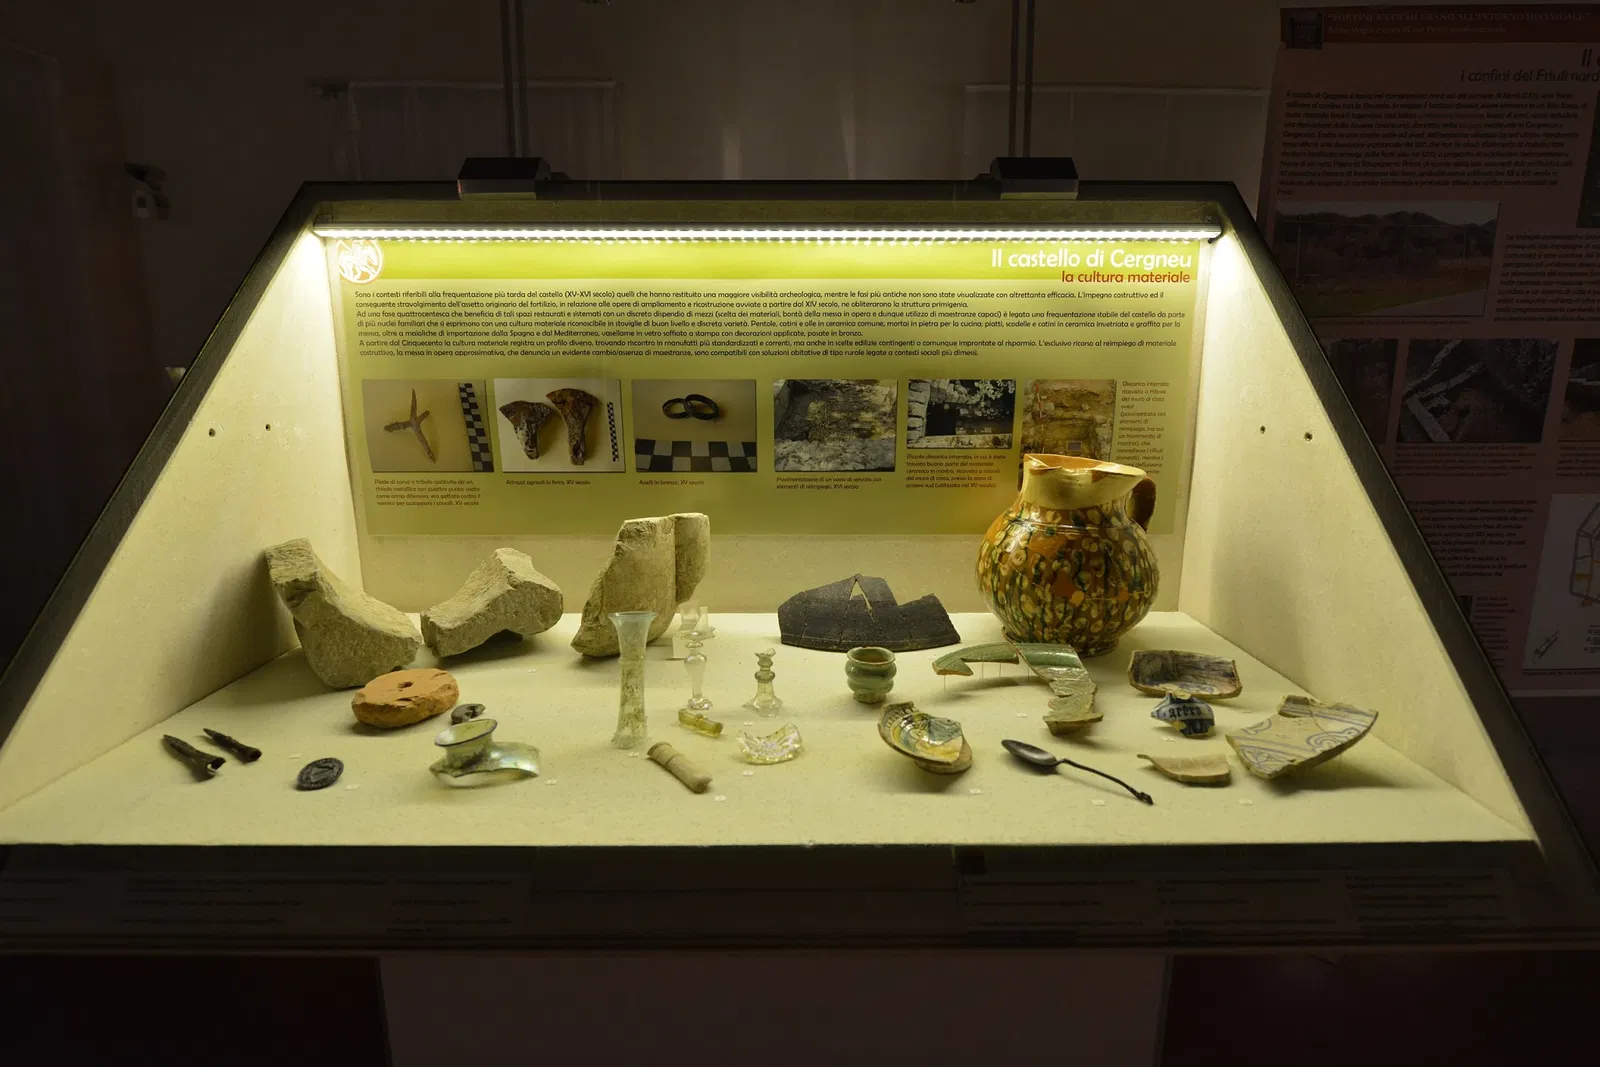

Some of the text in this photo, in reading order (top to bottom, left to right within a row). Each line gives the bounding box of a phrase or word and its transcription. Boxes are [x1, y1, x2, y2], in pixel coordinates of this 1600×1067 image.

[1581, 48, 1592, 67] Il
[1460, 70, 1464, 81] i
[1468, 70, 1510, 81] confini
[1513, 70, 1533, 81] del
[1536, 70, 1568, 81] Friuli
[992, 249, 1191, 270] Il castello di Cergneu
[1062, 271, 1190, 282] la cultura materiale
[442, 291, 492, 300] frequentazione
[494, 291, 505, 300] più
[616, 291, 634, 300] quelli
[718, 291, 749, 300] maggiore
[870, 291, 881, 300] più
[356, 301, 395, 309] conseguente
[397, 301, 446, 309] stravolgimento
[485, 301, 516, 310] originario
[640, 301, 686, 310] ampliamento
[769, 301, 791, 310] partire
[446, 330, 489, 338] importazione
[509, 330, 534, 338] Spagna
[695, 330, 719, 338] stampo
[807, 330, 829, 338] posate
[710, 349, 747, 358] compatibili
[829, 349, 843, 358] tipo
[866, 349, 886, 358] legate
[941, 349, 952, 358] più
